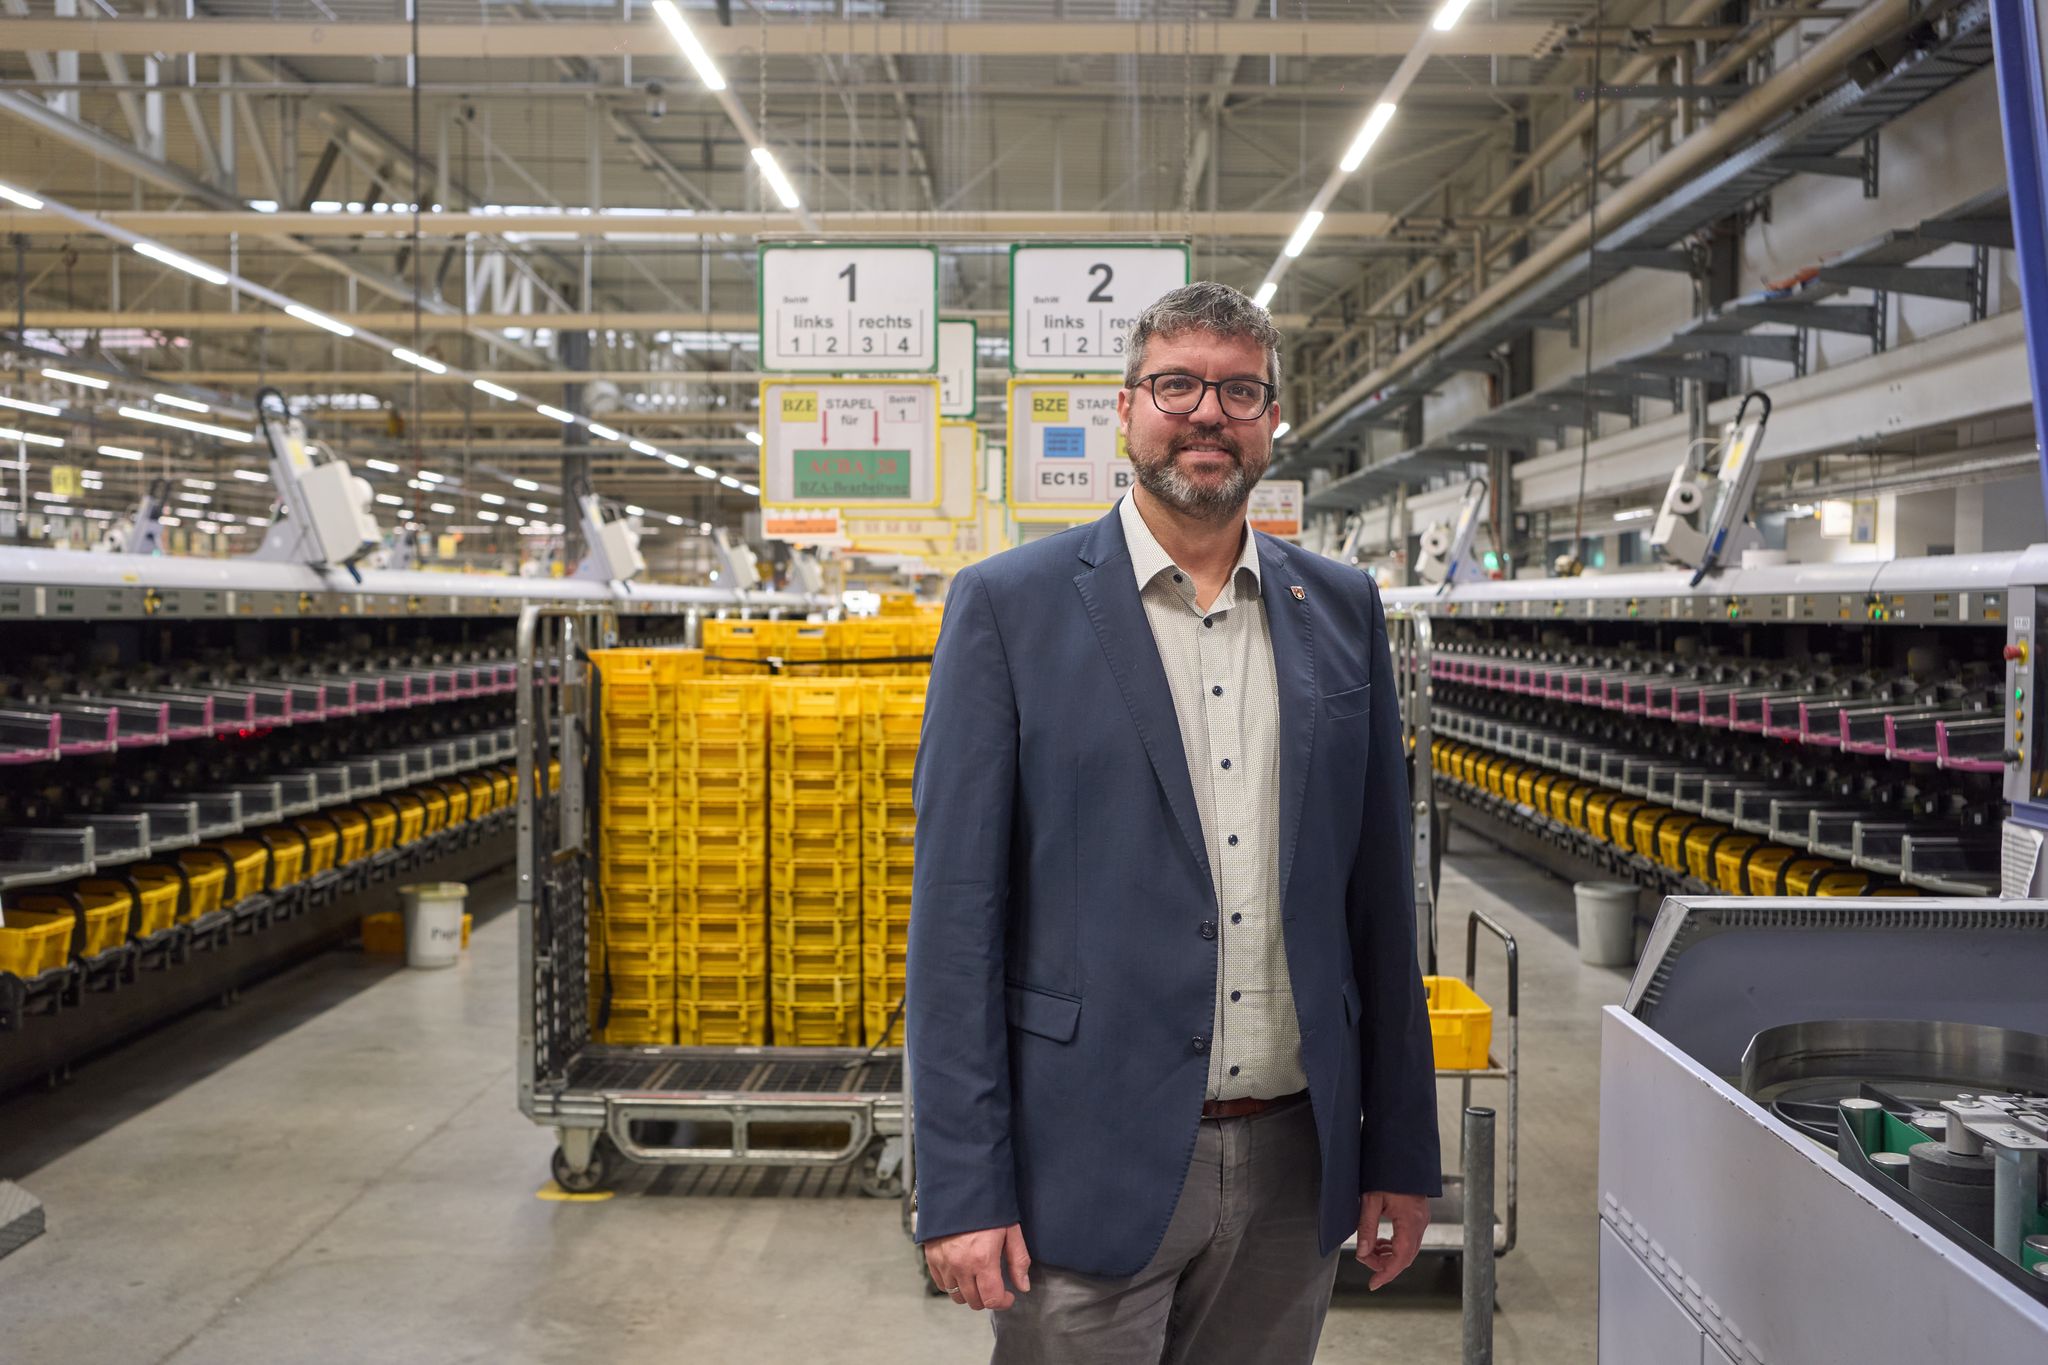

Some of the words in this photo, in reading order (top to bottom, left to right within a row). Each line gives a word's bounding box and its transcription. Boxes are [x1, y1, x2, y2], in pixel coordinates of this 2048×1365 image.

[838, 263, 857, 303] 1
[1087, 263, 1113, 303] 2
[793, 315, 834, 329] links
[858, 315, 912, 329] rechts
[1044, 315, 1085, 329] links
[1110, 317, 1137, 329] rec
[791, 337, 799, 353] 1
[826, 337, 838, 353] 2
[862, 337, 873, 353] 3
[897, 337, 909, 353] 4
[1041, 337, 1050, 353] 1
[1077, 337, 1088, 353] 2
[1113, 337, 1124, 353] 3
[783, 399, 816, 412] BZE
[826, 399, 875, 409] STAPEL
[1033, 398, 1067, 412] BZE
[1076, 399, 1117, 409] STAPE
[841, 414, 858, 425] für
[899, 409, 906, 421] 1
[1092, 415, 1110, 425] für
[1041, 472, 1089, 486] EC15
